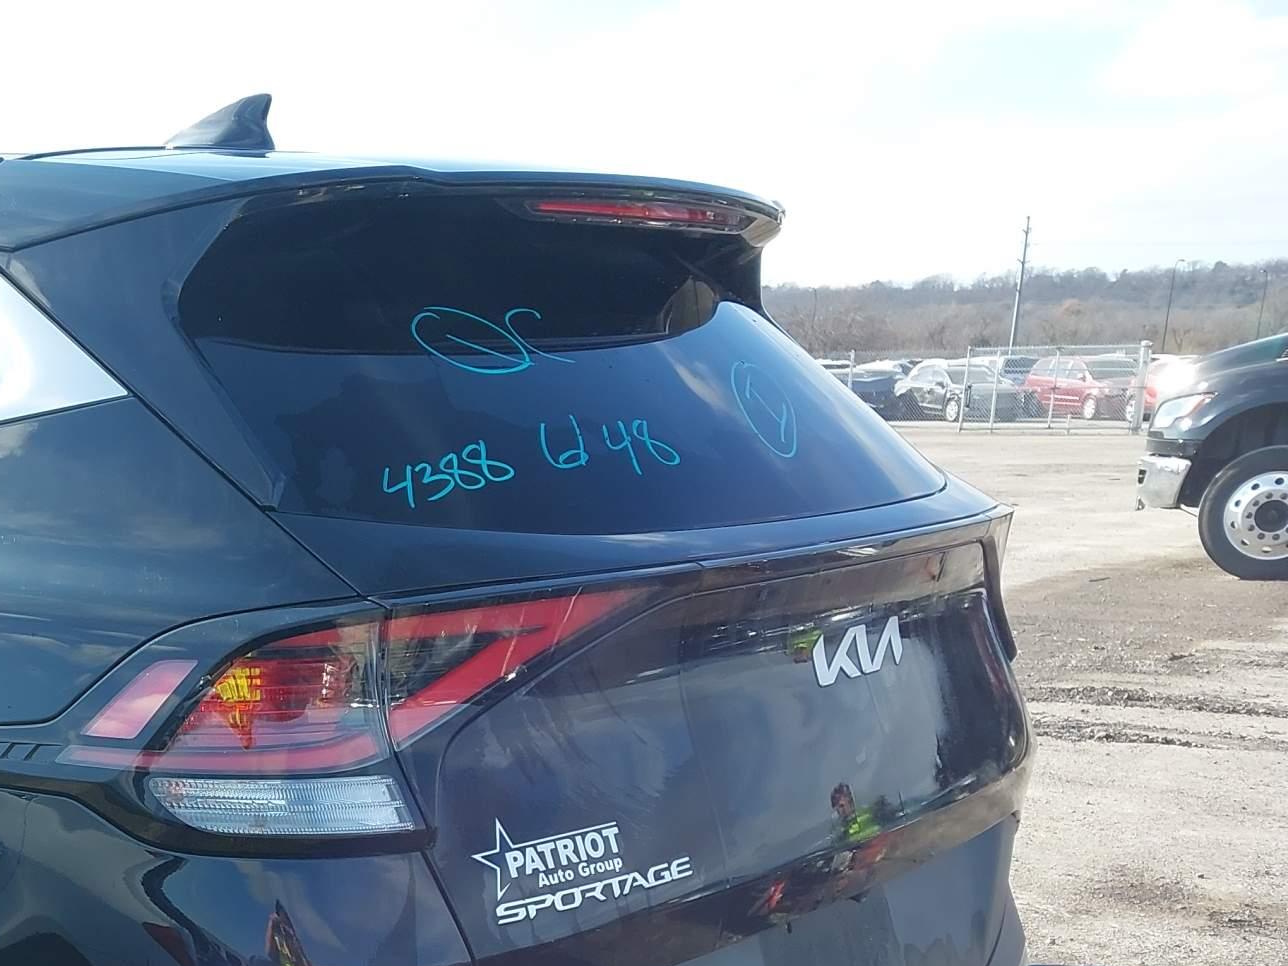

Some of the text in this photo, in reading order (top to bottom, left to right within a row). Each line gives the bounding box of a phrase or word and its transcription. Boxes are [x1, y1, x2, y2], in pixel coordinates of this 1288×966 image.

[383, 439, 515, 508] 4388
[504, 826, 620, 879] PATRIOT
[537, 856, 623, 888] Auto Group
[495, 856, 694, 925] SPORTAGE
